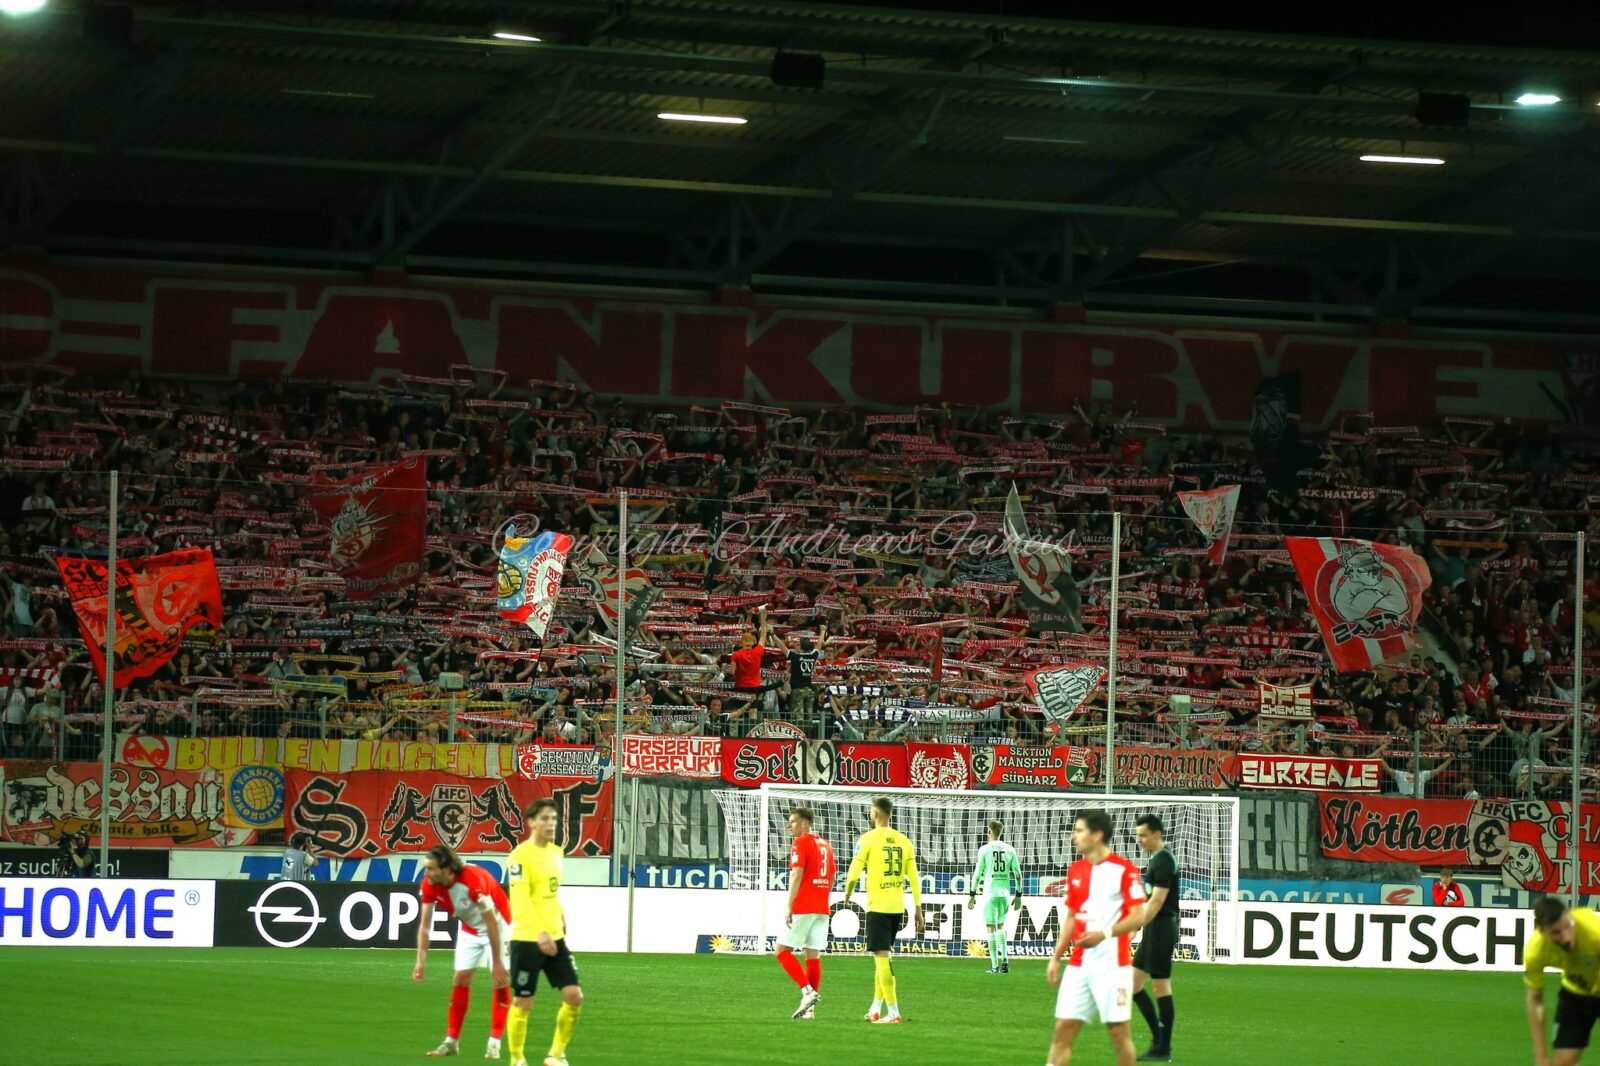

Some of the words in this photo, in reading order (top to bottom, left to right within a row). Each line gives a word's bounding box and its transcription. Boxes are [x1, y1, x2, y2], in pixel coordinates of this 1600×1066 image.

[1261, 686, 1312, 704] HFC
[541, 751, 592, 763] SEKTION
[1009, 746, 1053, 756] SEKTION
[533, 763, 599, 776] WEISSENFELS
[999, 757, 1063, 769] MANSFELD
[1002, 771, 1057, 786] SÜDHARZ
[1241, 761, 1380, 787] SURREALE
[438, 787, 467, 800] HFC
[1322, 799, 1470, 853] Köthen
[820, 846, 828, 877] 3
[882, 846, 903, 877] 33
[992, 850, 1006, 872] 35
